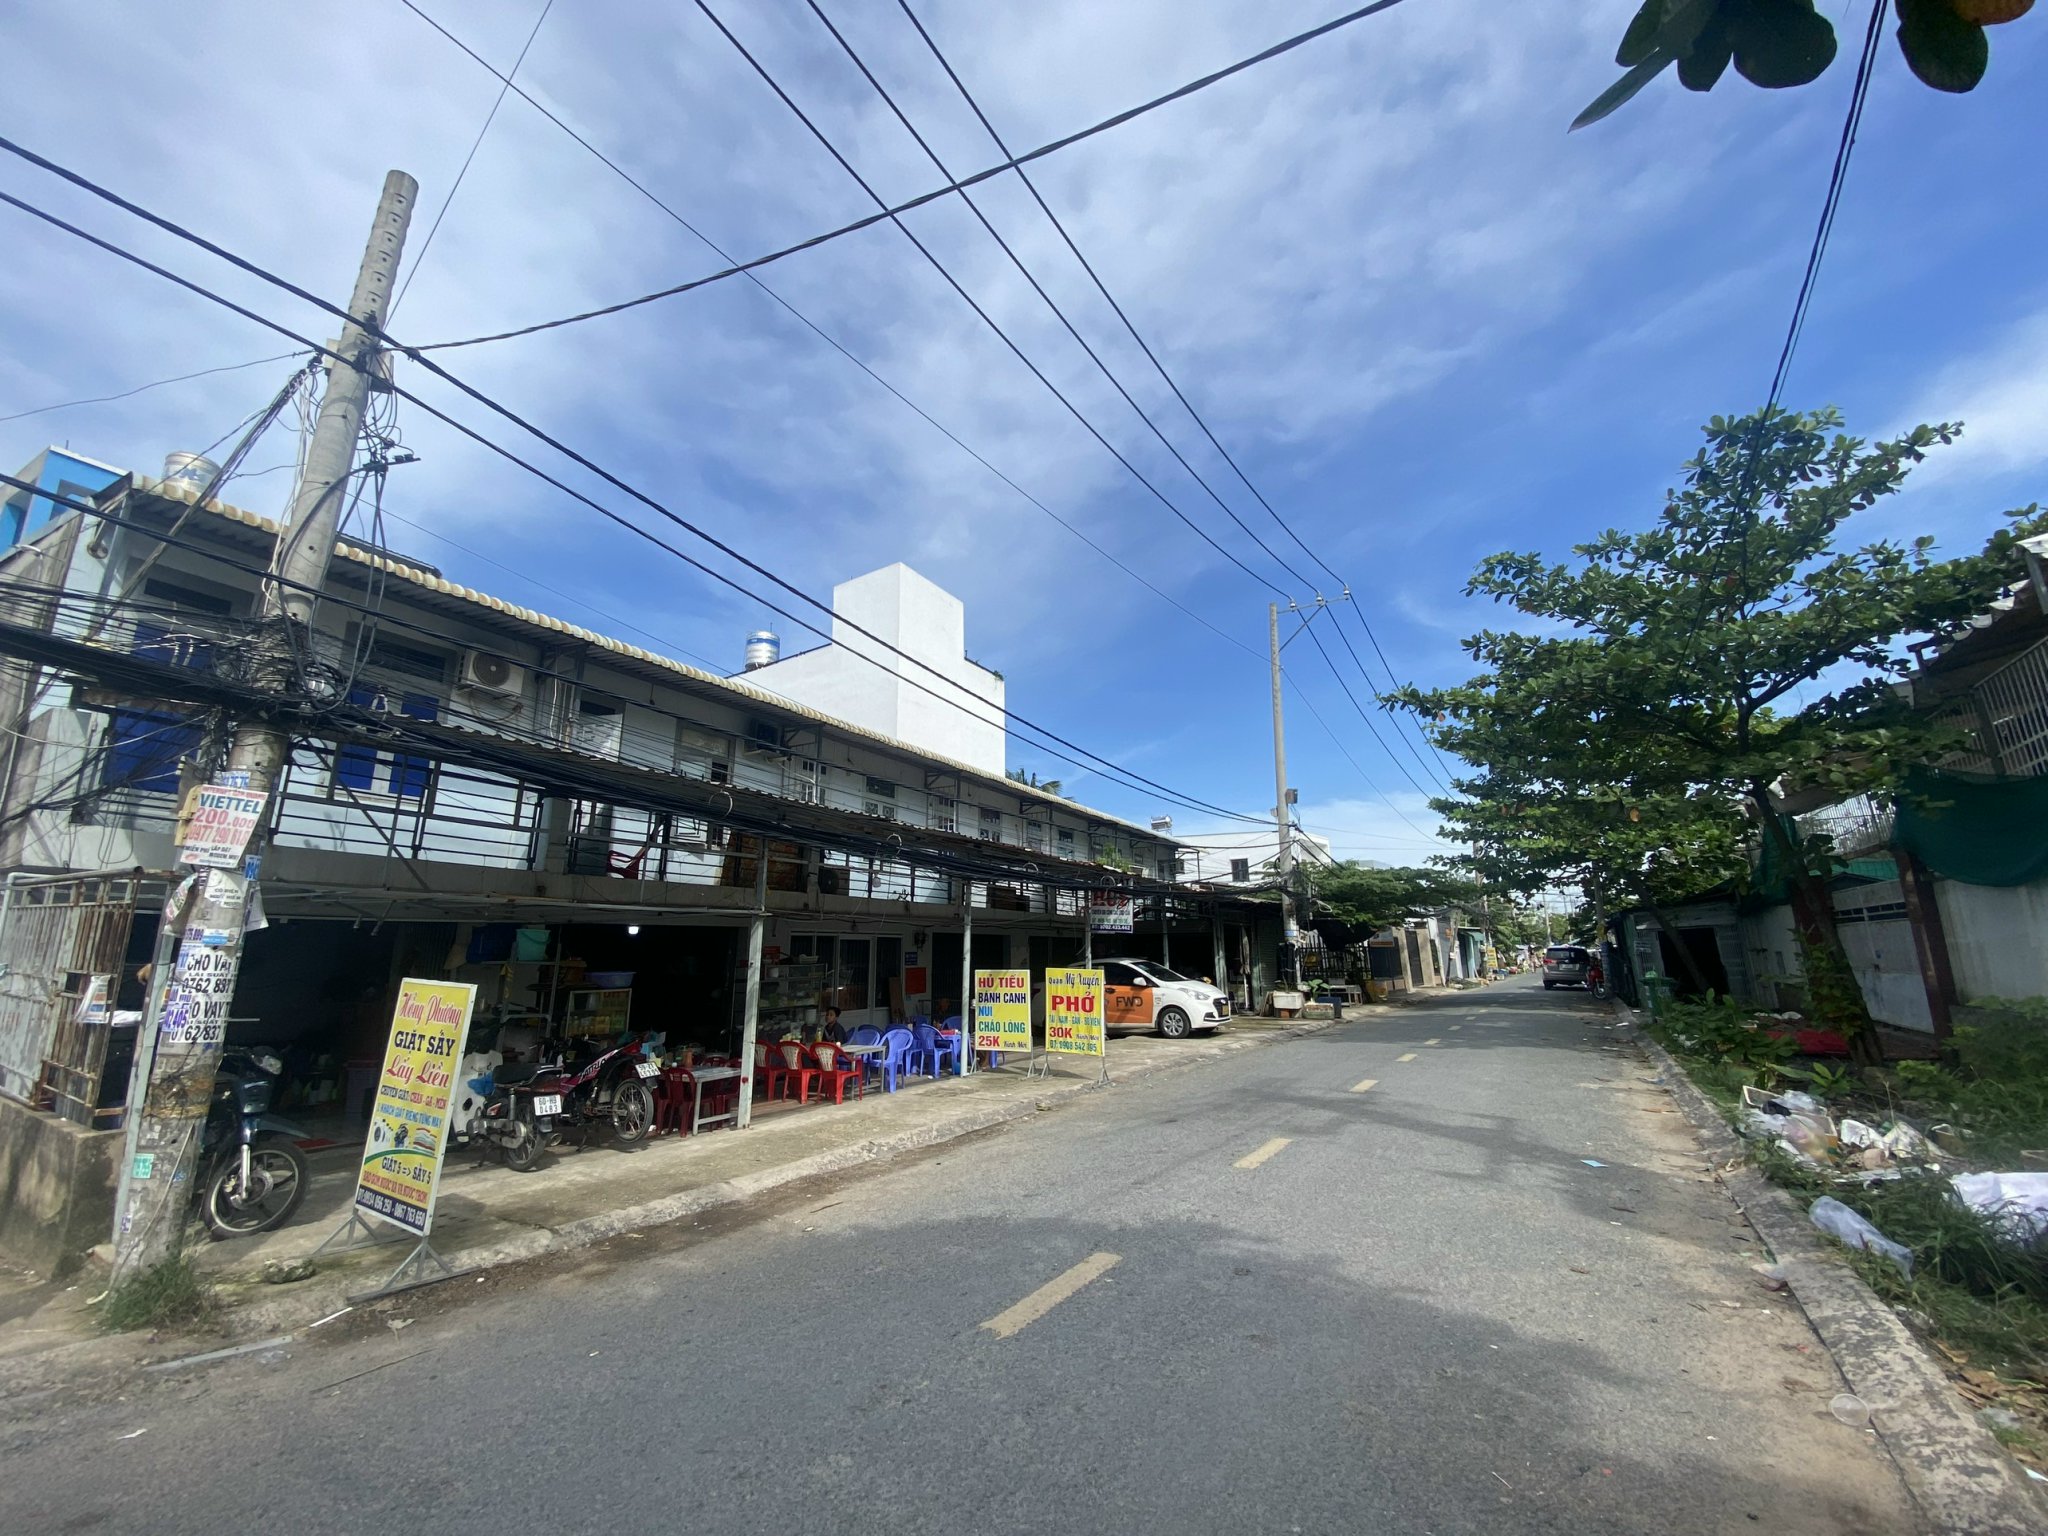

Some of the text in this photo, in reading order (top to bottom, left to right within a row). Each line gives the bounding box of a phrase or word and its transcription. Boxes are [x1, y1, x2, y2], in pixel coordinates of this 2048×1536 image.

[201, 793, 261, 814] VIETTEL
[194, 807, 256, 829] 200.000
[978, 974, 1025, 989] HỦ TIẾU
[978, 990, 1026, 1004] BÁNH CANH
[1051, 991, 1095, 1013] PHỞ
[1115, 996, 1144, 1007] FWD
[205, 1000, 225, 1018] VAY
[978, 1006, 993, 1017] NUI
[978, 1018, 1026, 1033] CHÁO LÒNG
[1049, 1026, 1073, 1039] 30K
[394, 1029, 456, 1057] GIẶT SẤY
[978, 1035, 1000, 1047] 25K
